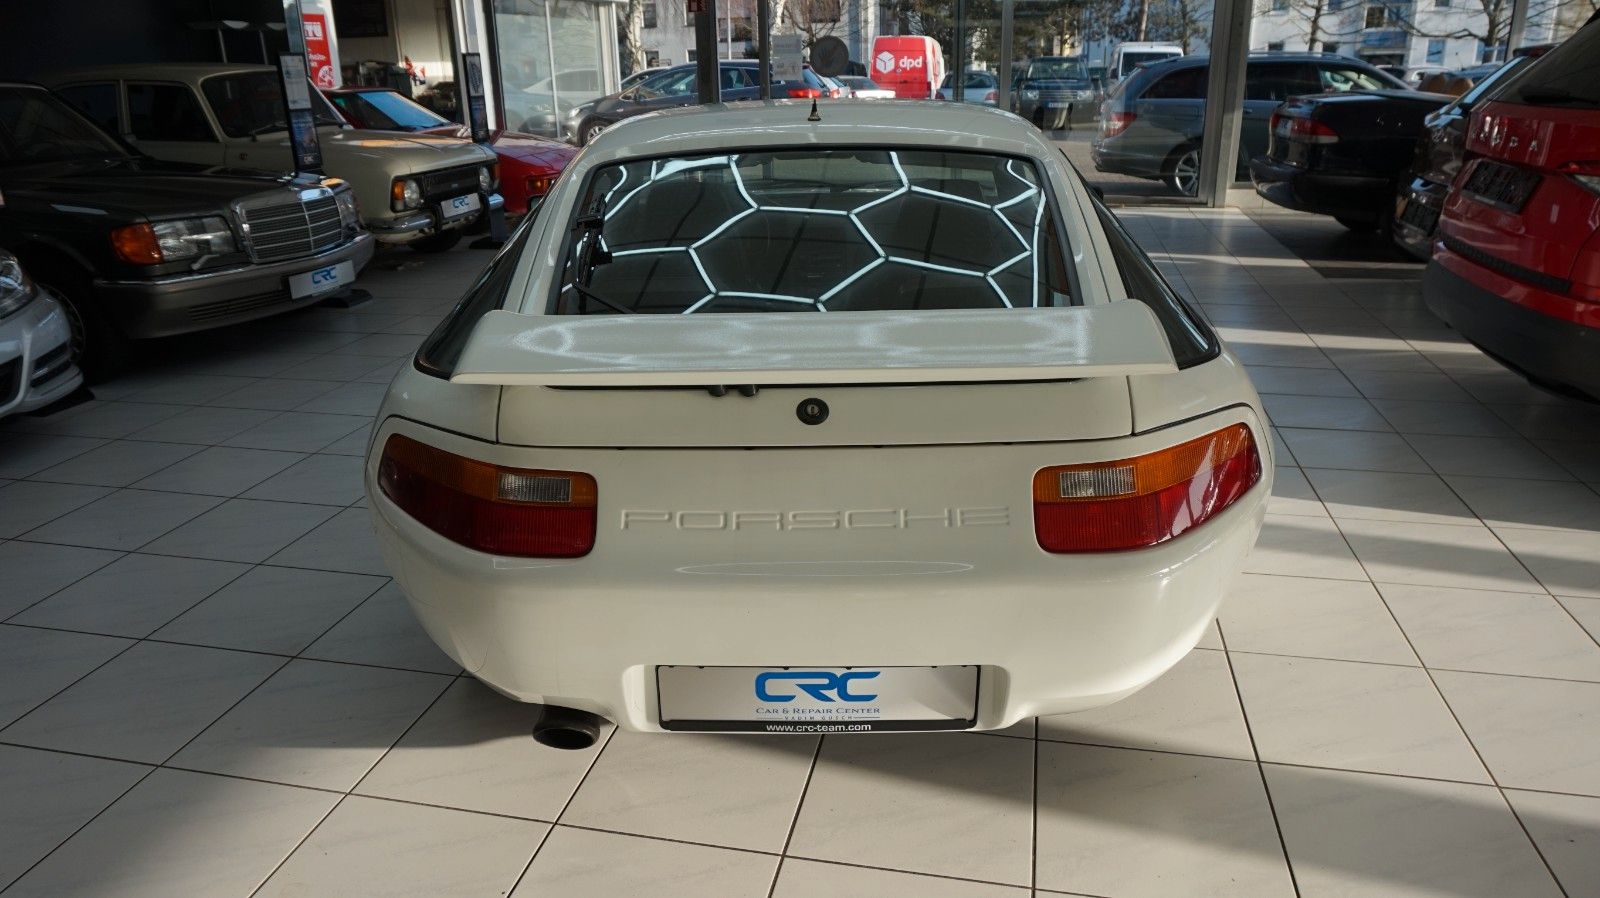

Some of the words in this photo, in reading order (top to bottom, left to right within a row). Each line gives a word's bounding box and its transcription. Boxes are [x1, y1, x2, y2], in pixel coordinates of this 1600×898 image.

[899, 56, 922, 70] dpd
[453, 196, 469, 208] CRC
[312, 267, 336, 285] CRC
[620, 506, 1010, 530] PORSCHE
[755, 671, 881, 703] CRC
[766, 723, 872, 732] www.crc-team.com
